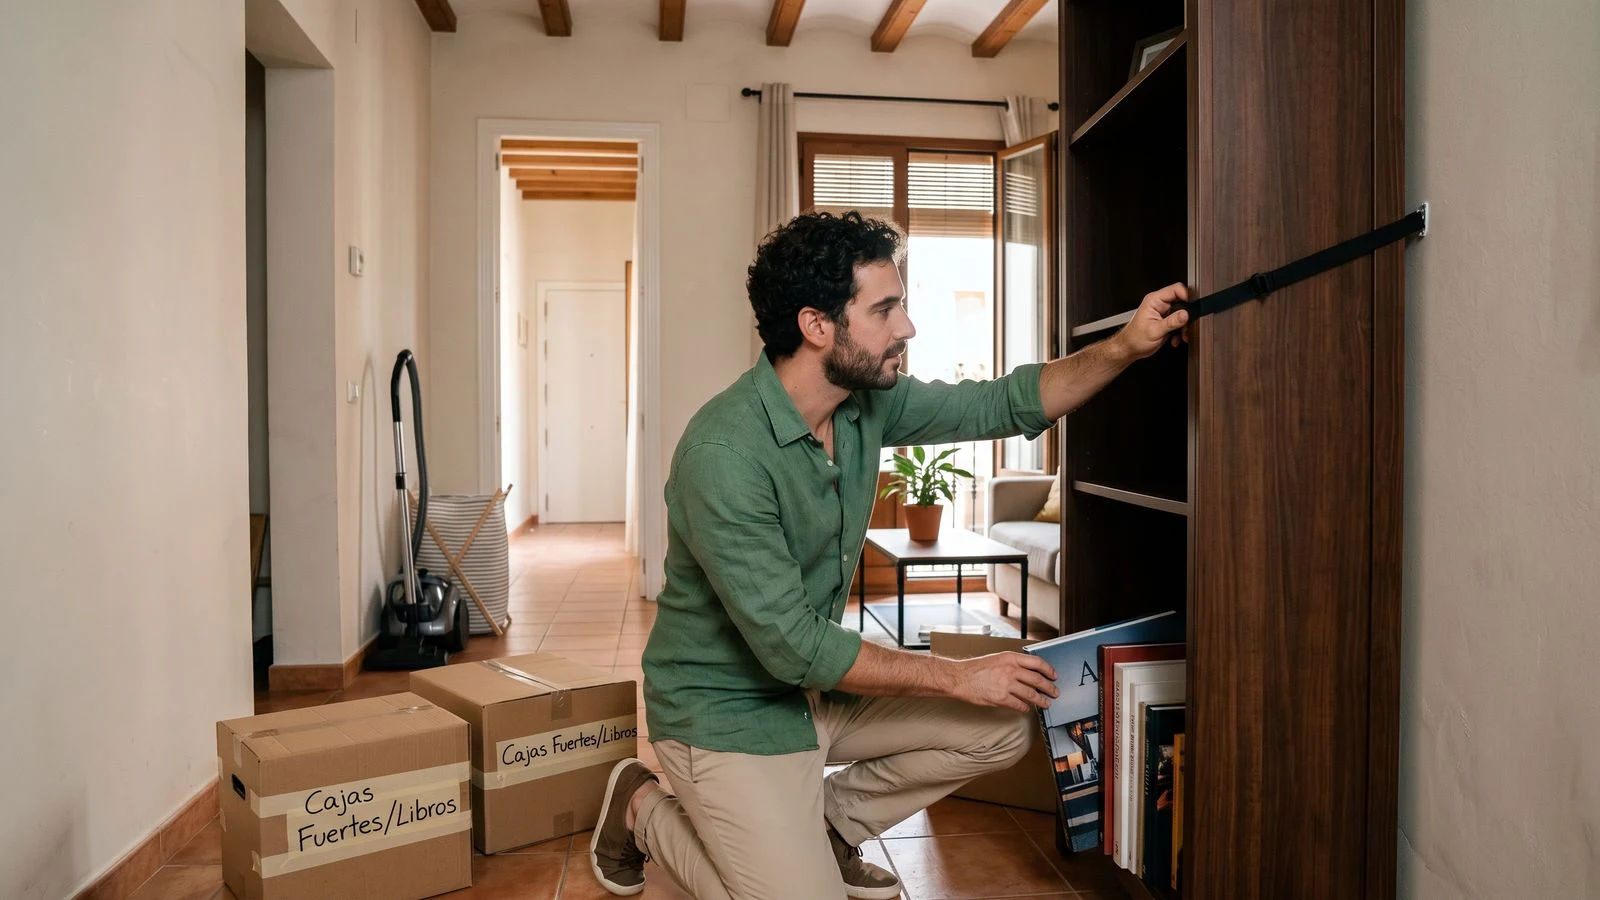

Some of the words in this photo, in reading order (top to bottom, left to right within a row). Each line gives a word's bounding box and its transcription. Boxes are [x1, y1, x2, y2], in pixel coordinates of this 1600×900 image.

[502, 743, 548, 767] Cajas
[552, 724, 637, 754] Fuertes/Libros
[305, 787, 374, 817] Cajas
[298, 798, 457, 852] Fuertes/Libros
